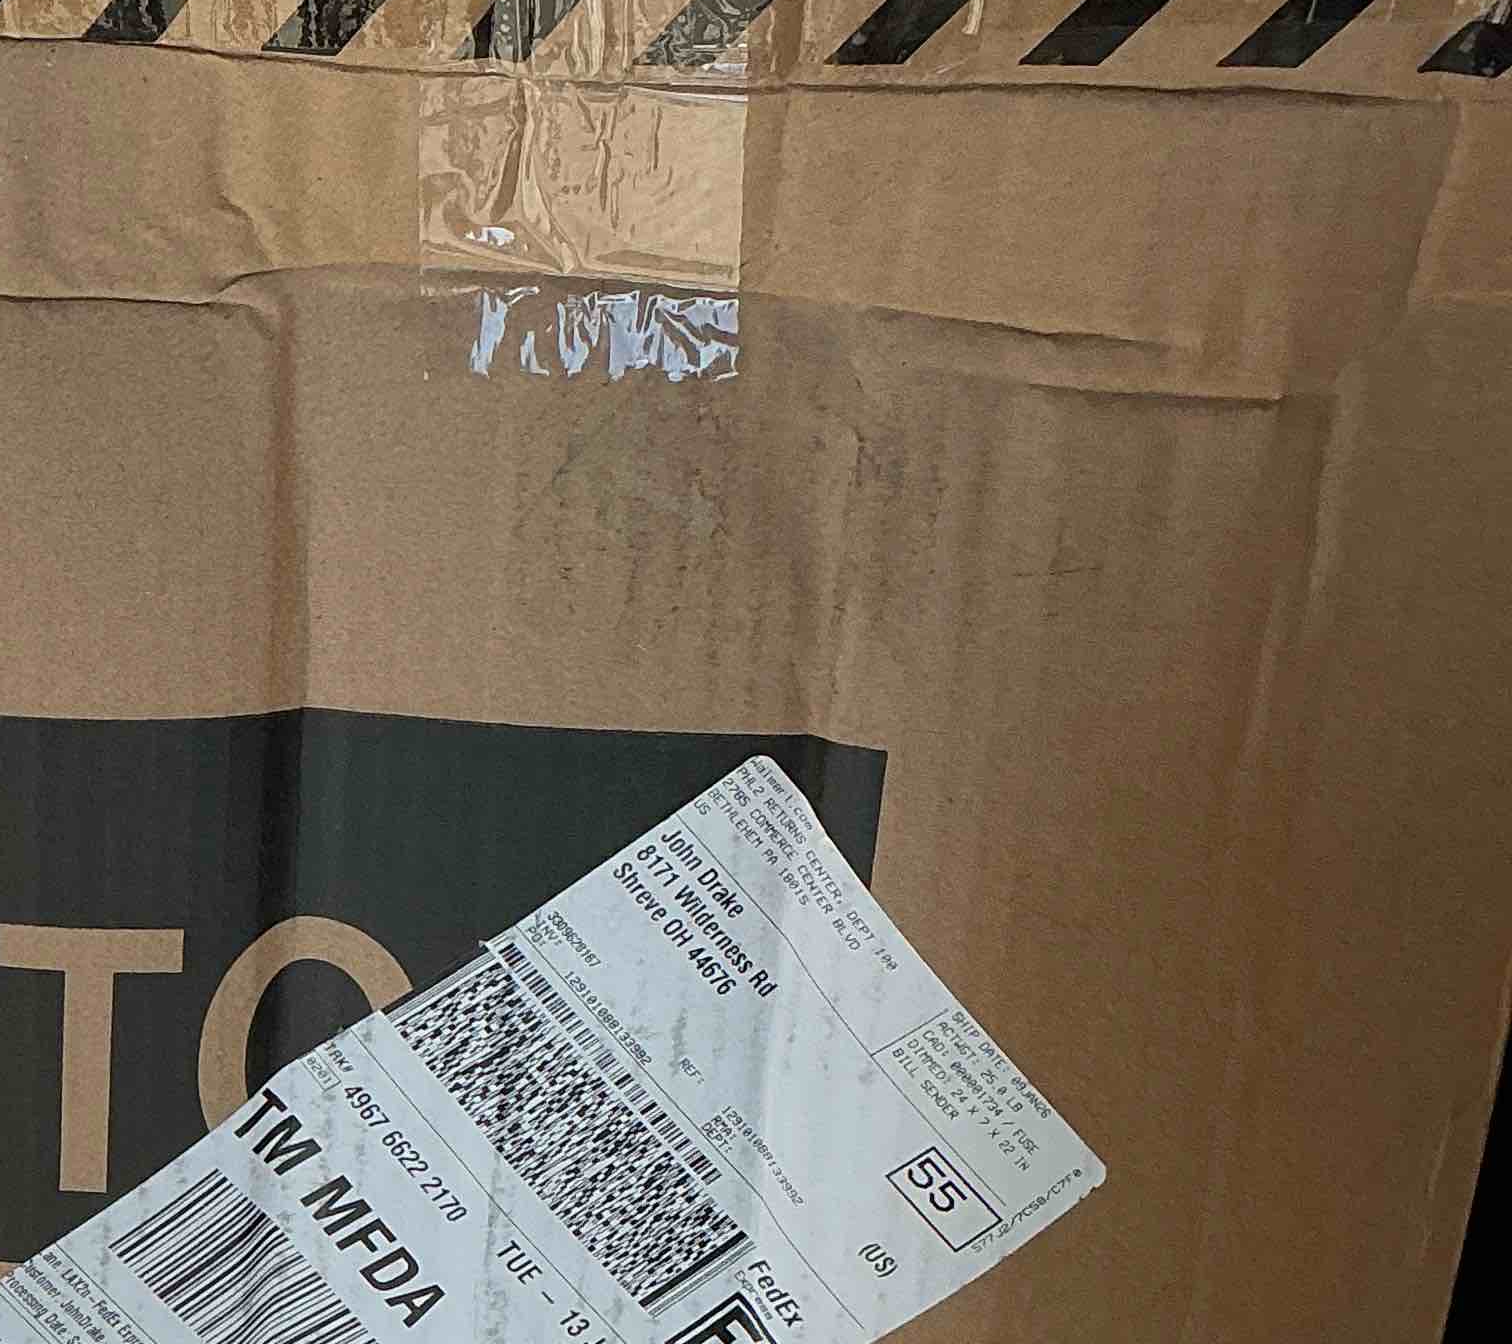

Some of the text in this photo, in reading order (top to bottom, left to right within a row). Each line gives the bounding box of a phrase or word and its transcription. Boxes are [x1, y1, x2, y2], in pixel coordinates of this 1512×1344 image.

[693, 799, 713, 817] US
[709, 790, 764, 849] BETHLEHEM
[760, 847, 780, 867] PA
[660, 829, 745, 919] John Drake
[749, 807, 800, 862] COMMERCE
[788, 863, 839, 915] CENTER
[831, 917, 862, 951] BLVD
[762, 796, 808, 845] RETURNS
[845, 909, 876, 942] DEPT
[612, 861, 738, 996] Shreve OH 44676
[636, 844, 779, 999] 8171 Wilderness Rd
[526, 925, 547, 948] PO:
[700, 1121, 734, 1154] DEPT:
[535, 919, 738, 1141] INV: RMA:
[677, 1056, 706, 1085] REF:
[937, 1020, 980, 1065] ACTWGT:
[1004, 1095, 1025, 1114] LB
[950, 1010, 981, 1038] SHIP
[977, 1041, 1007, 1073] DATE:
[891, 1046, 960, 1121] BILL SENDER
[906, 1037, 1032, 1173] DIMMED: 24 X 7 X 22 IN
[921, 1029, 950, 1058] CAD:
[1011, 1127, 1041, 1157] FUSE
[343, 1085, 391, 1128] 4967
[381, 1130, 430, 1179] 6622
[419, 1175, 468, 1223] 2170
[906, 1156, 968, 1213] 55
[221, 1088, 322, 1176] TM
[301, 1176, 444, 1327] MFDA
[495, 1239, 544, 1286] TUE
[559, 1309, 591, 1338] 13
[739, 1259, 804, 1328] FedEx
[857, 1242, 899, 1279] (US)
